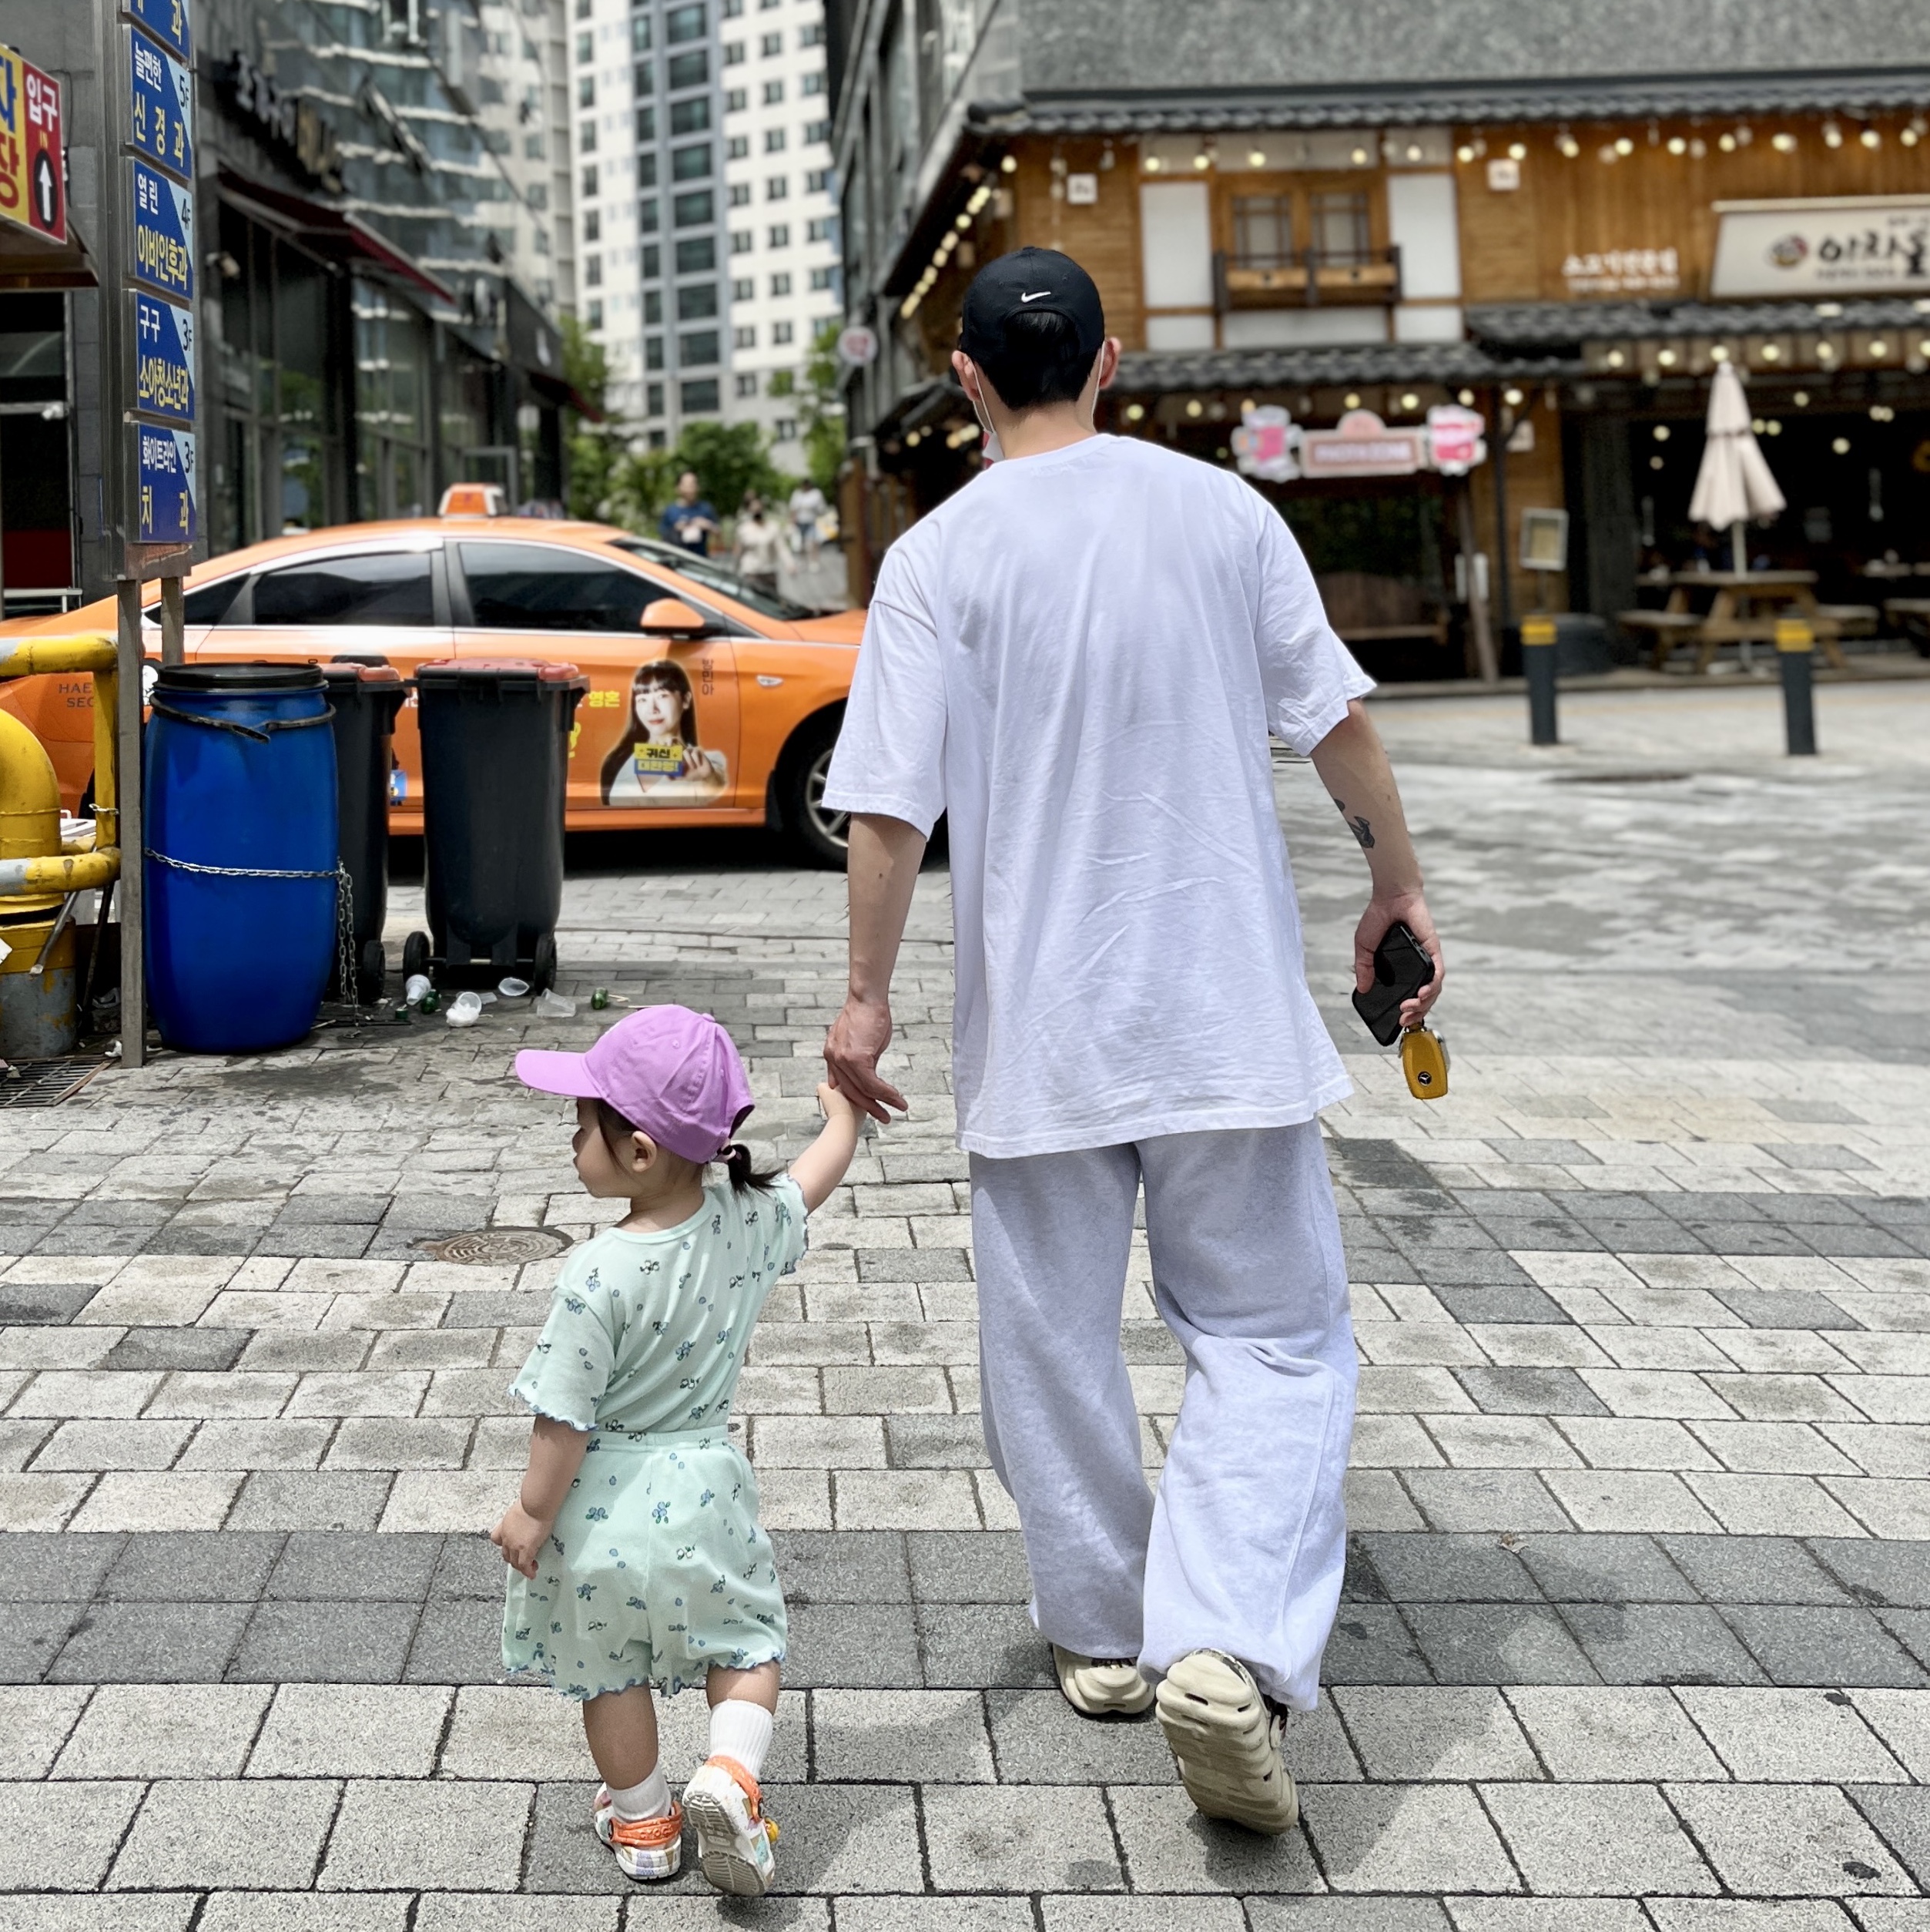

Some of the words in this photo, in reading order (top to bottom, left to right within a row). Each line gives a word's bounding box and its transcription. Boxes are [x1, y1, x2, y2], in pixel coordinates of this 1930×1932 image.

[26, 74, 58, 132] 입구
[179, 75, 189, 109] 5F
[138, 173, 159, 215] 열린
[181, 198, 190, 230] 4F
[138, 224, 187, 290] 이비인후과
[140, 304, 160, 343] 구구
[183, 318, 192, 352] 3F
[139, 354, 189, 413] 소아청소년과
[142, 435, 176, 473] 화이트라인
[185, 441, 193, 474] 3F
[588, 690, 620, 707] 영혼
[646, 748, 671, 759] 귀신
